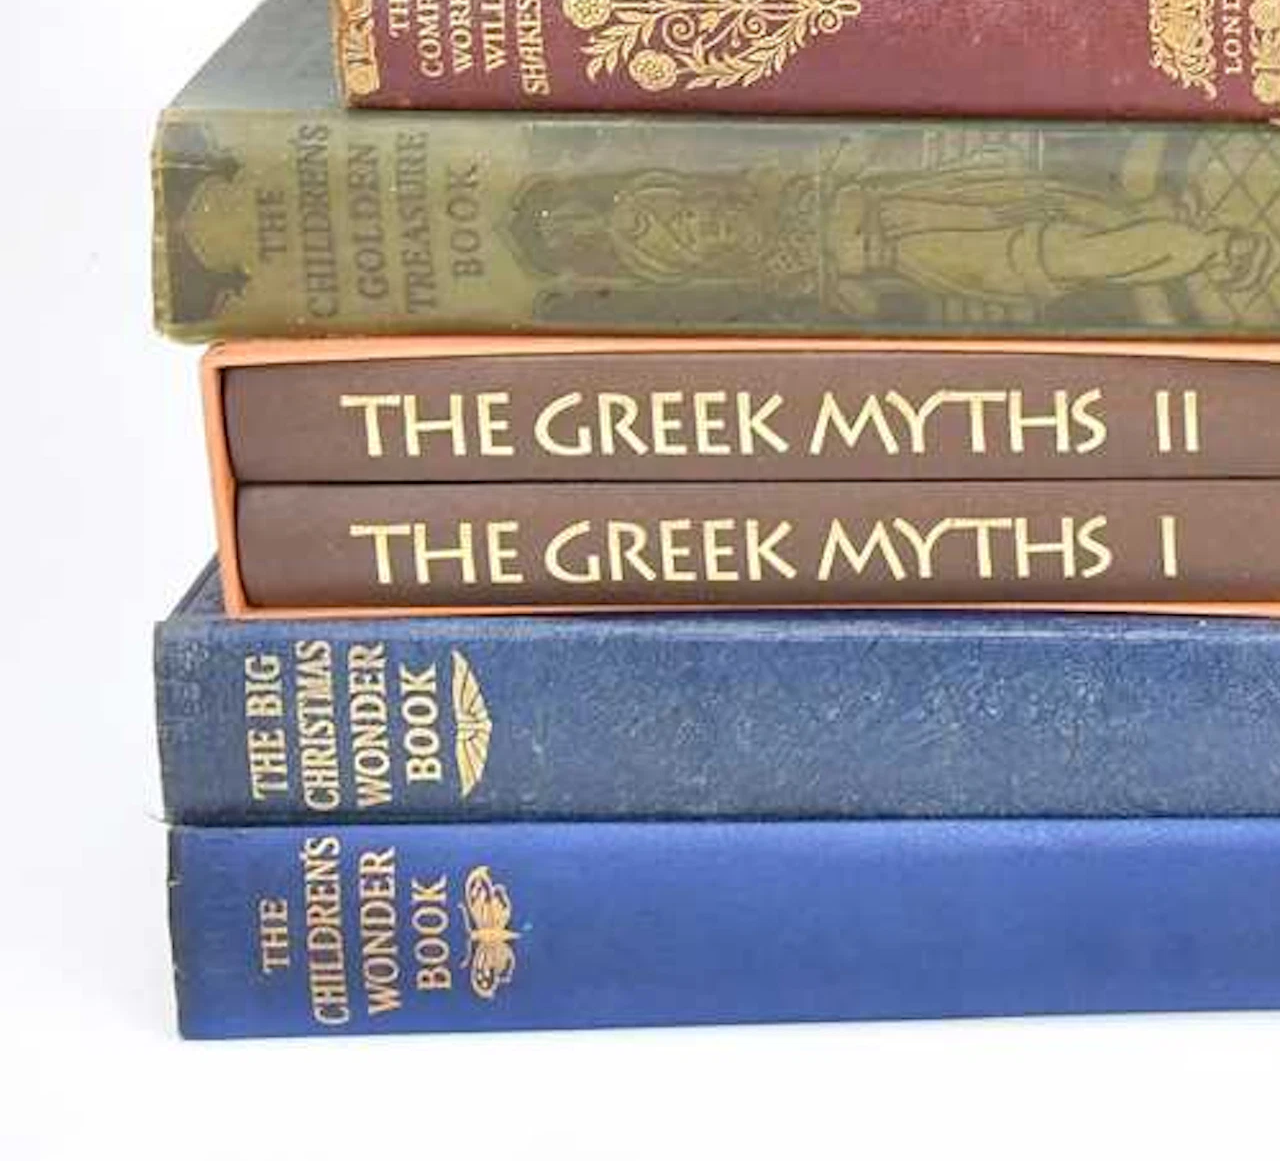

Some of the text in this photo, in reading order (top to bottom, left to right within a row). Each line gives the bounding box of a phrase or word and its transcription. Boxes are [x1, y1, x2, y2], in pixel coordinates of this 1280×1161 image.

[256, 189, 287, 262] THE
[347, 142, 390, 300] GOLDEN
[396, 132, 438, 315] TREASURE
[445, 164, 485, 278] BOOK
[339, 389, 1200, 457] THE GREEK MYTHS II
[349, 515, 1175, 585] THE GREEK MYTHS I
[244, 653, 288, 801] THE BIG
[295, 639, 341, 812] CHRISTMAS
[346, 641, 393, 808] WONDER
[399, 661, 442, 784] BOOK
[258, 898, 291, 975] THE
[298, 835, 351, 1026] CHILDREN'S
[358, 845, 402, 1016] WONDER
[410, 873, 453, 992] BOOK
